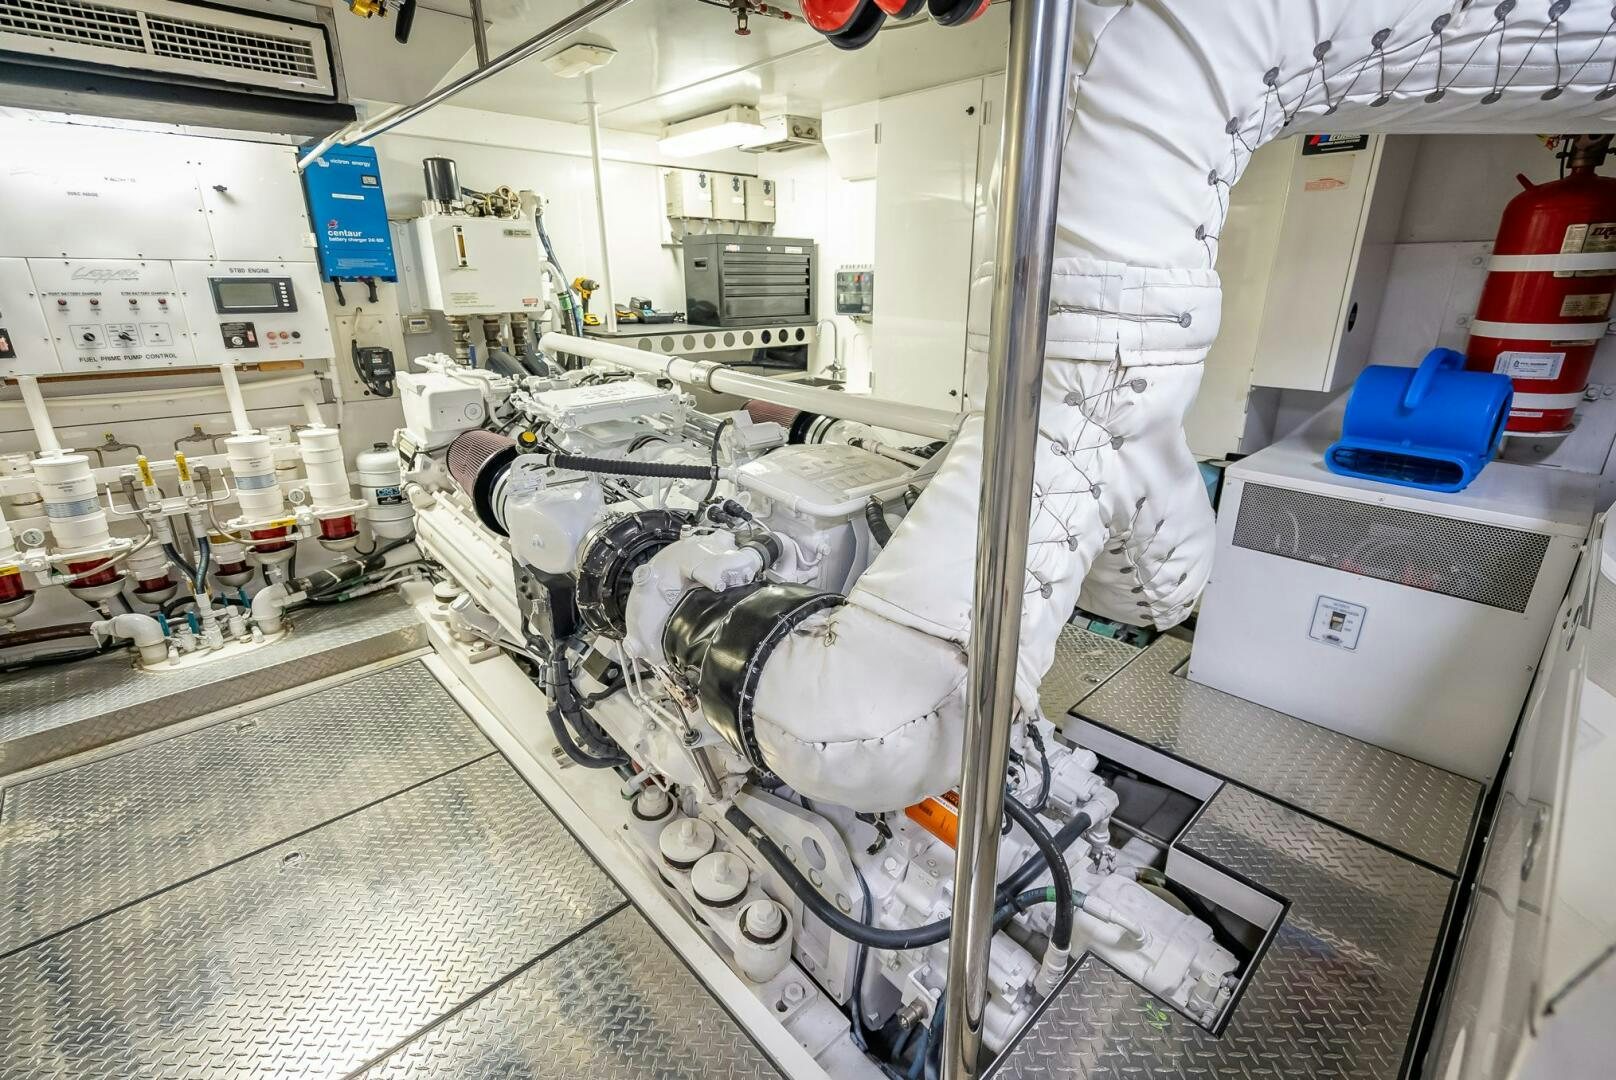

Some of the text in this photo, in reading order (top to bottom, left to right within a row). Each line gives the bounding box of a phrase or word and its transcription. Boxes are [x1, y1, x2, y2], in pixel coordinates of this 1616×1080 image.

[351, 160, 370, 168] energy
[327, 229, 362, 237] centaur
[79, 355, 98, 363] FUEL
[145, 352, 177, 360] CONTROL
